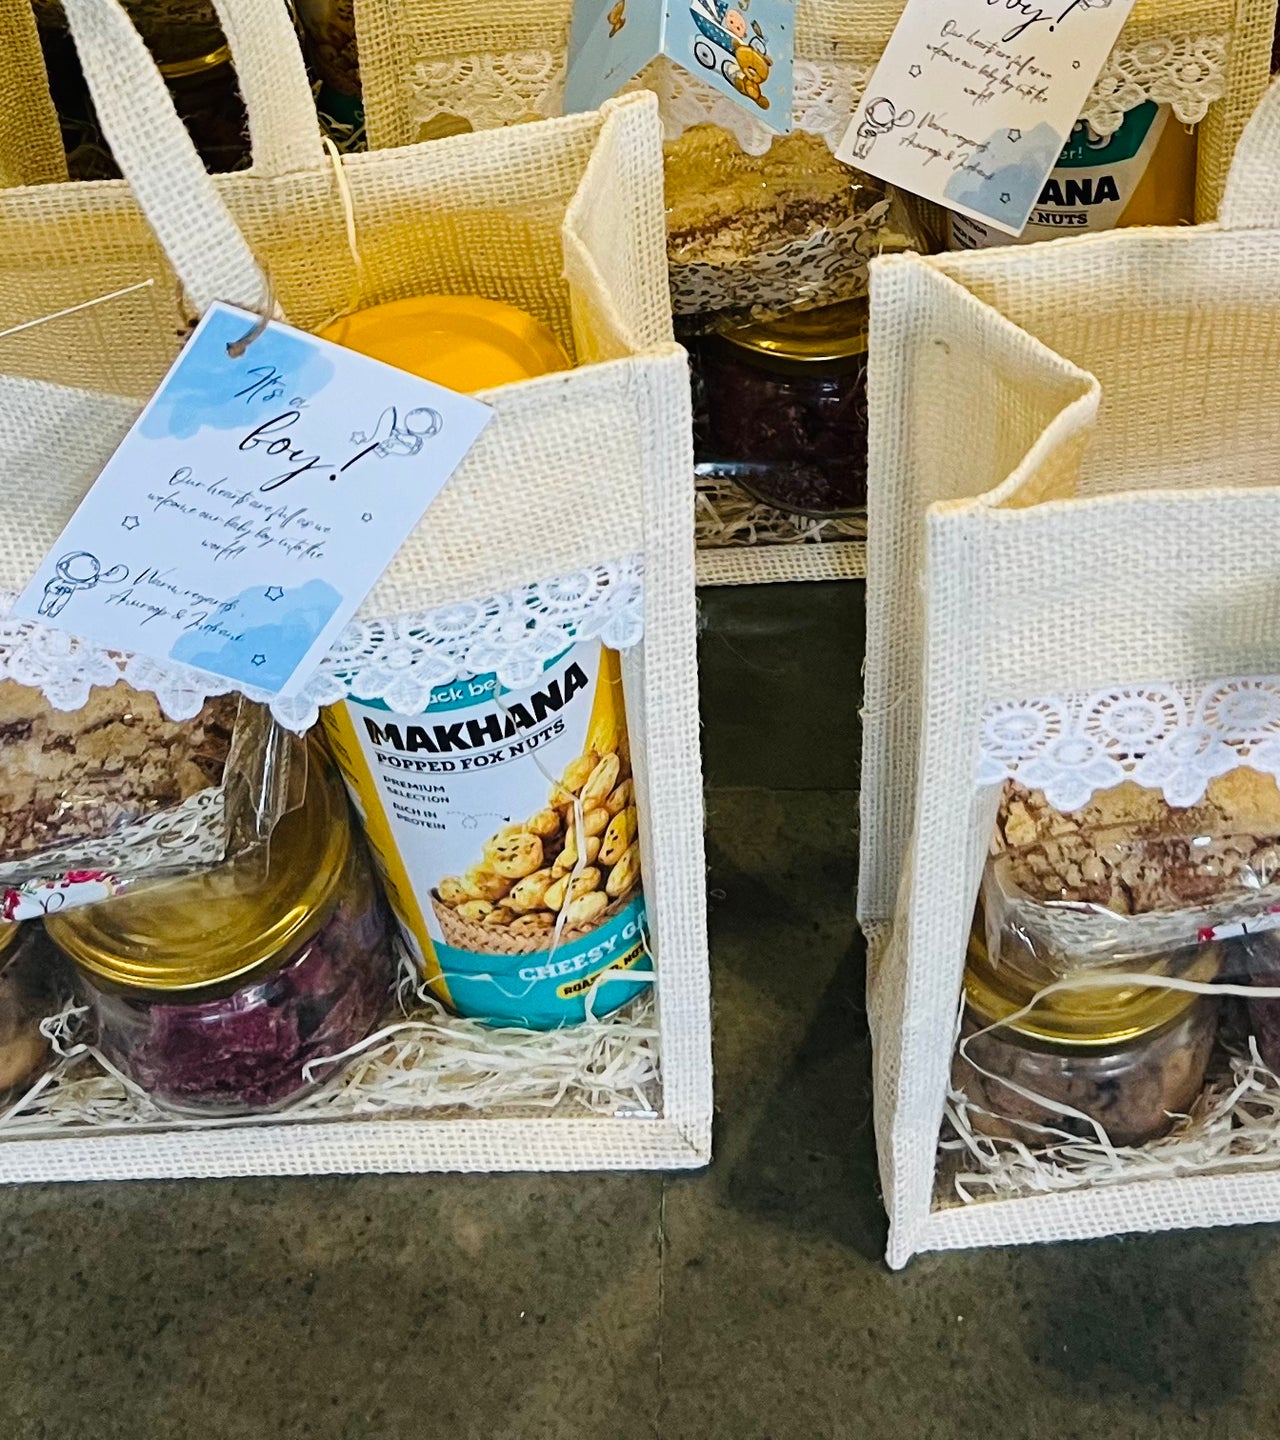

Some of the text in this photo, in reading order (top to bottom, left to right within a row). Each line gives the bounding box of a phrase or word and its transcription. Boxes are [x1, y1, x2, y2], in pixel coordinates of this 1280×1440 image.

[1038, 211, 1087, 225] NUTS
[240, 411, 377, 491] boy!
[363, 662, 588, 754] MAKHANA
[376, 718, 565, 773] POPPED FOX NUTS
[383, 775, 445, 793] PREMIUM
[386, 786, 450, 804] SELECTION
[392, 802, 437, 819] RICH IN
[397, 813, 447, 831] PROTEIN
[519, 935, 618, 982] CHEESY
